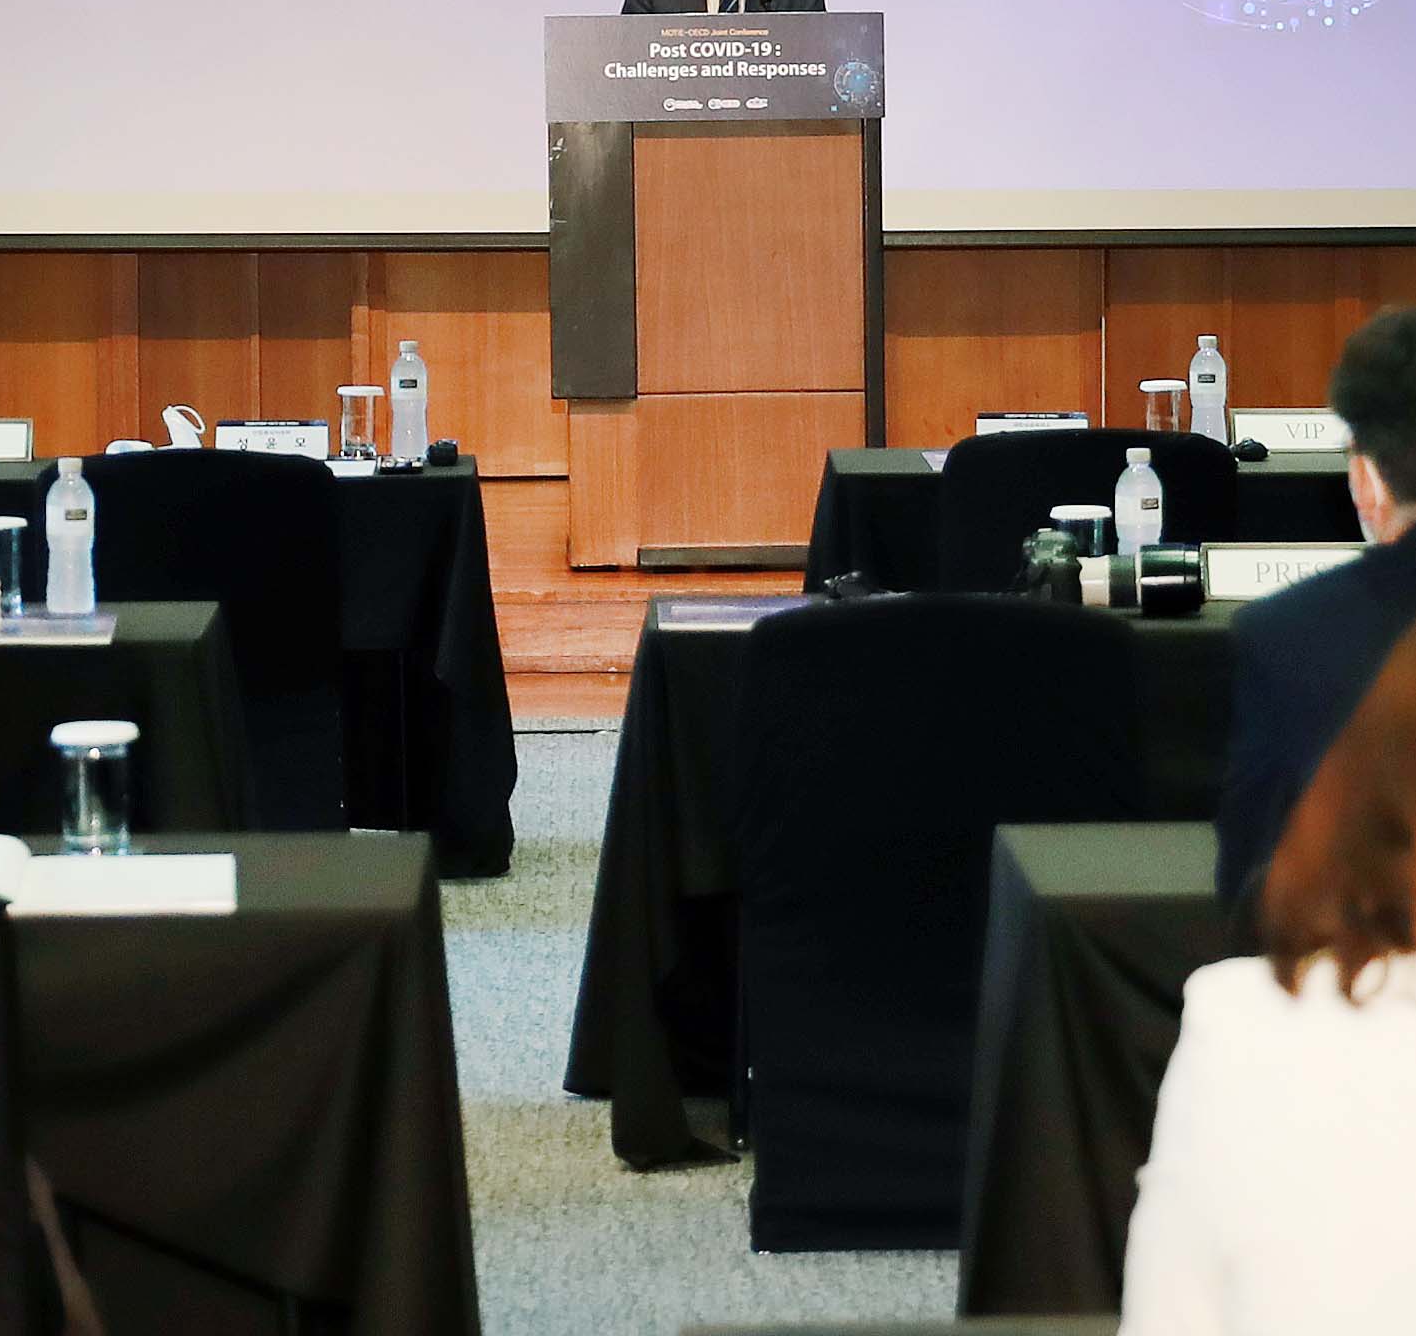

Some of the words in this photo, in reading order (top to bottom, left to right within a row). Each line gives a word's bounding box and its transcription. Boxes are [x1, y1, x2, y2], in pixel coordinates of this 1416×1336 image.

[649, 43, 687, 59] Post
[604, 61, 698, 82] Challenges
[701, 61, 734, 77] and
[737, 61, 827, 80] Responses
[1285, 422, 1326, 440] VIP
